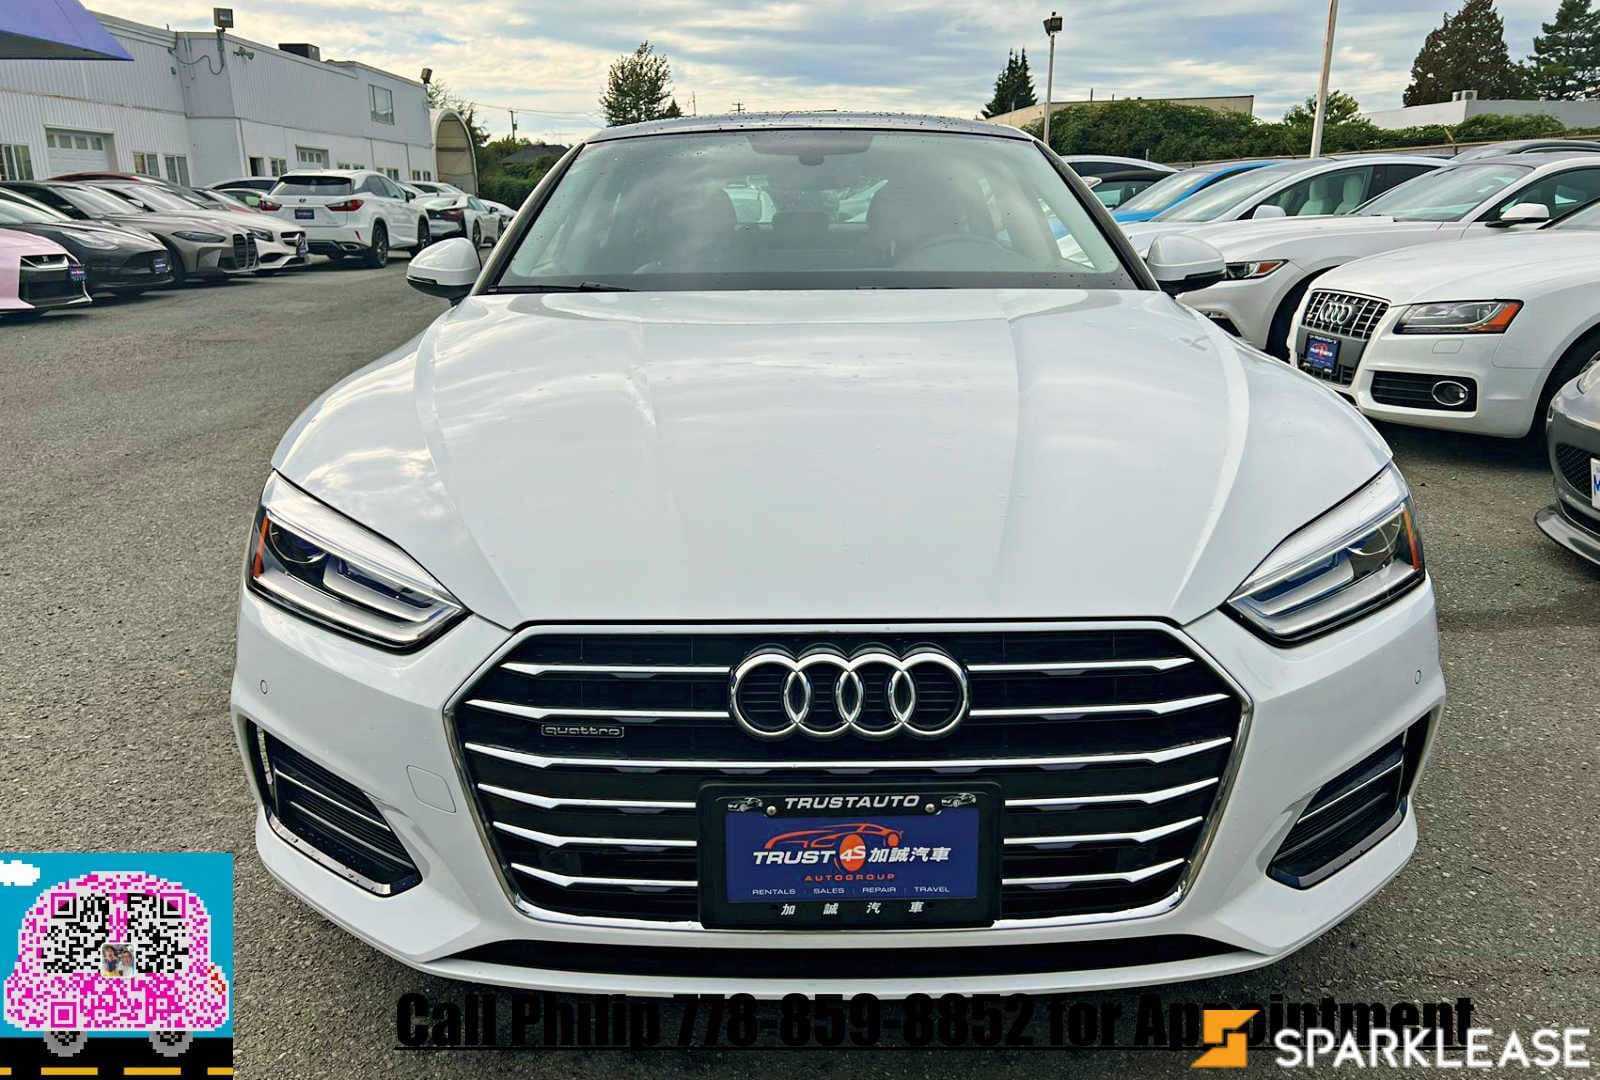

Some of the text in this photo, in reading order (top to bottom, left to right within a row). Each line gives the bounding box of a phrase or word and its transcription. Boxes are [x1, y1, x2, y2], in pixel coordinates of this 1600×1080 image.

[544, 726, 620, 736] quattro
[785, 795, 920, 810] TRUSTAUTO
[753, 850, 836, 865] TRUST
[840, 845, 866, 862] 4S
[804, 873, 897, 882] AUTOGROUP
[752, 885, 951, 896] RENTALS SALES REPAIR TRAVEL
